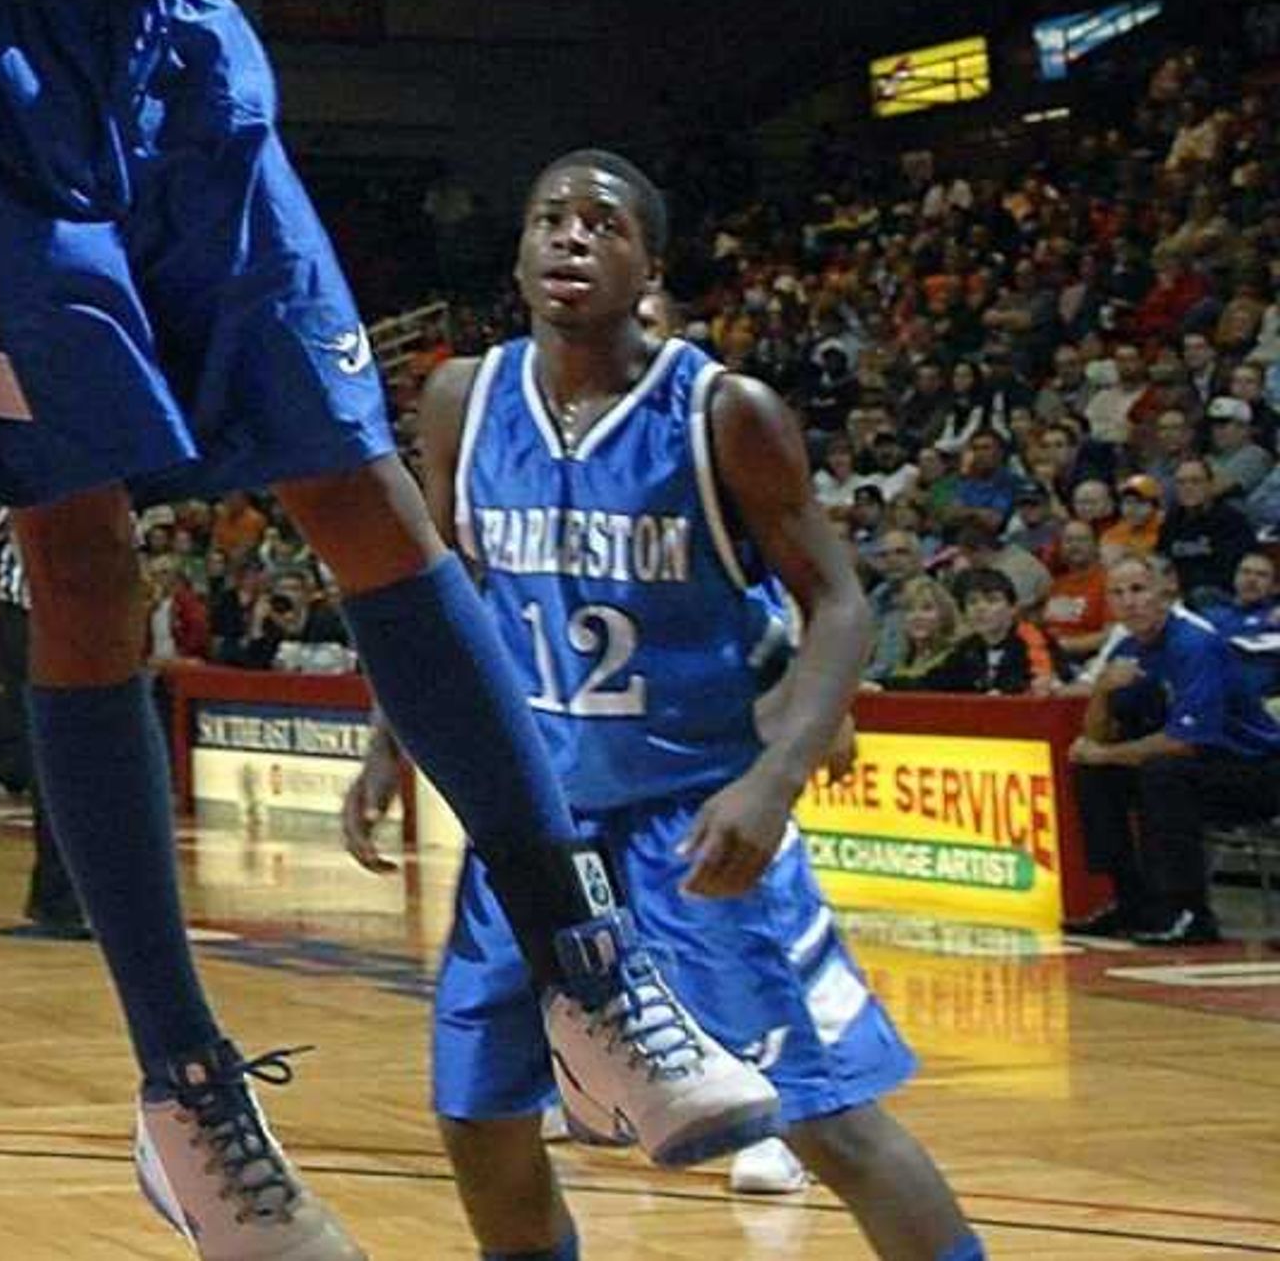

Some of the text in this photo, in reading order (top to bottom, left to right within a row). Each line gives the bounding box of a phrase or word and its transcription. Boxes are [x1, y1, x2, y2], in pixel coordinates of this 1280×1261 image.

[520, 600, 647, 718] 12
[839, 839, 933, 878] CHANGE
[935, 846, 1019, 886] ARTIST
[894, 764, 1055, 872] SERVICE
